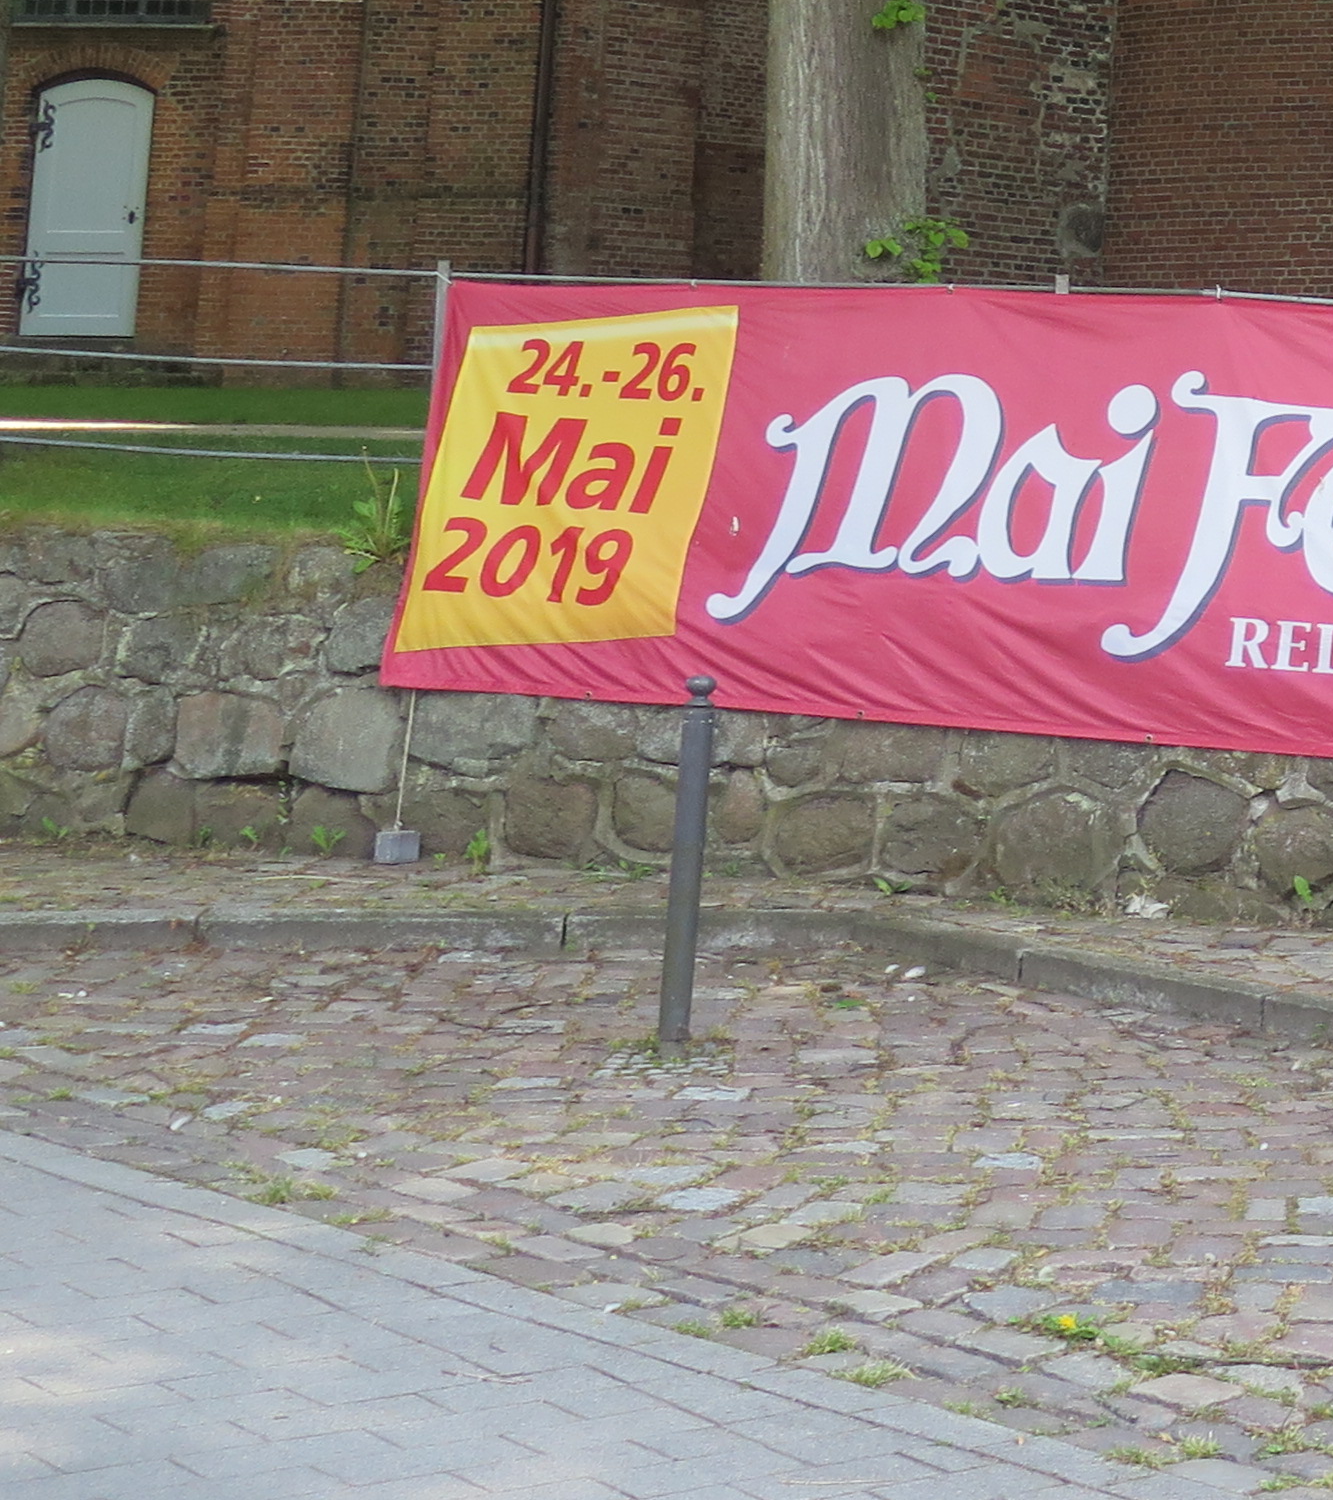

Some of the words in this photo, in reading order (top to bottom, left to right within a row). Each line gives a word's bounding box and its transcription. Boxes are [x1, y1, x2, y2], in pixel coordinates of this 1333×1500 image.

[506, 338, 706, 402] 24.-26.
[460, 411, 682, 514] Mai
[706, 375, 1157, 622] Mai
[422, 516, 634, 606] 2019
